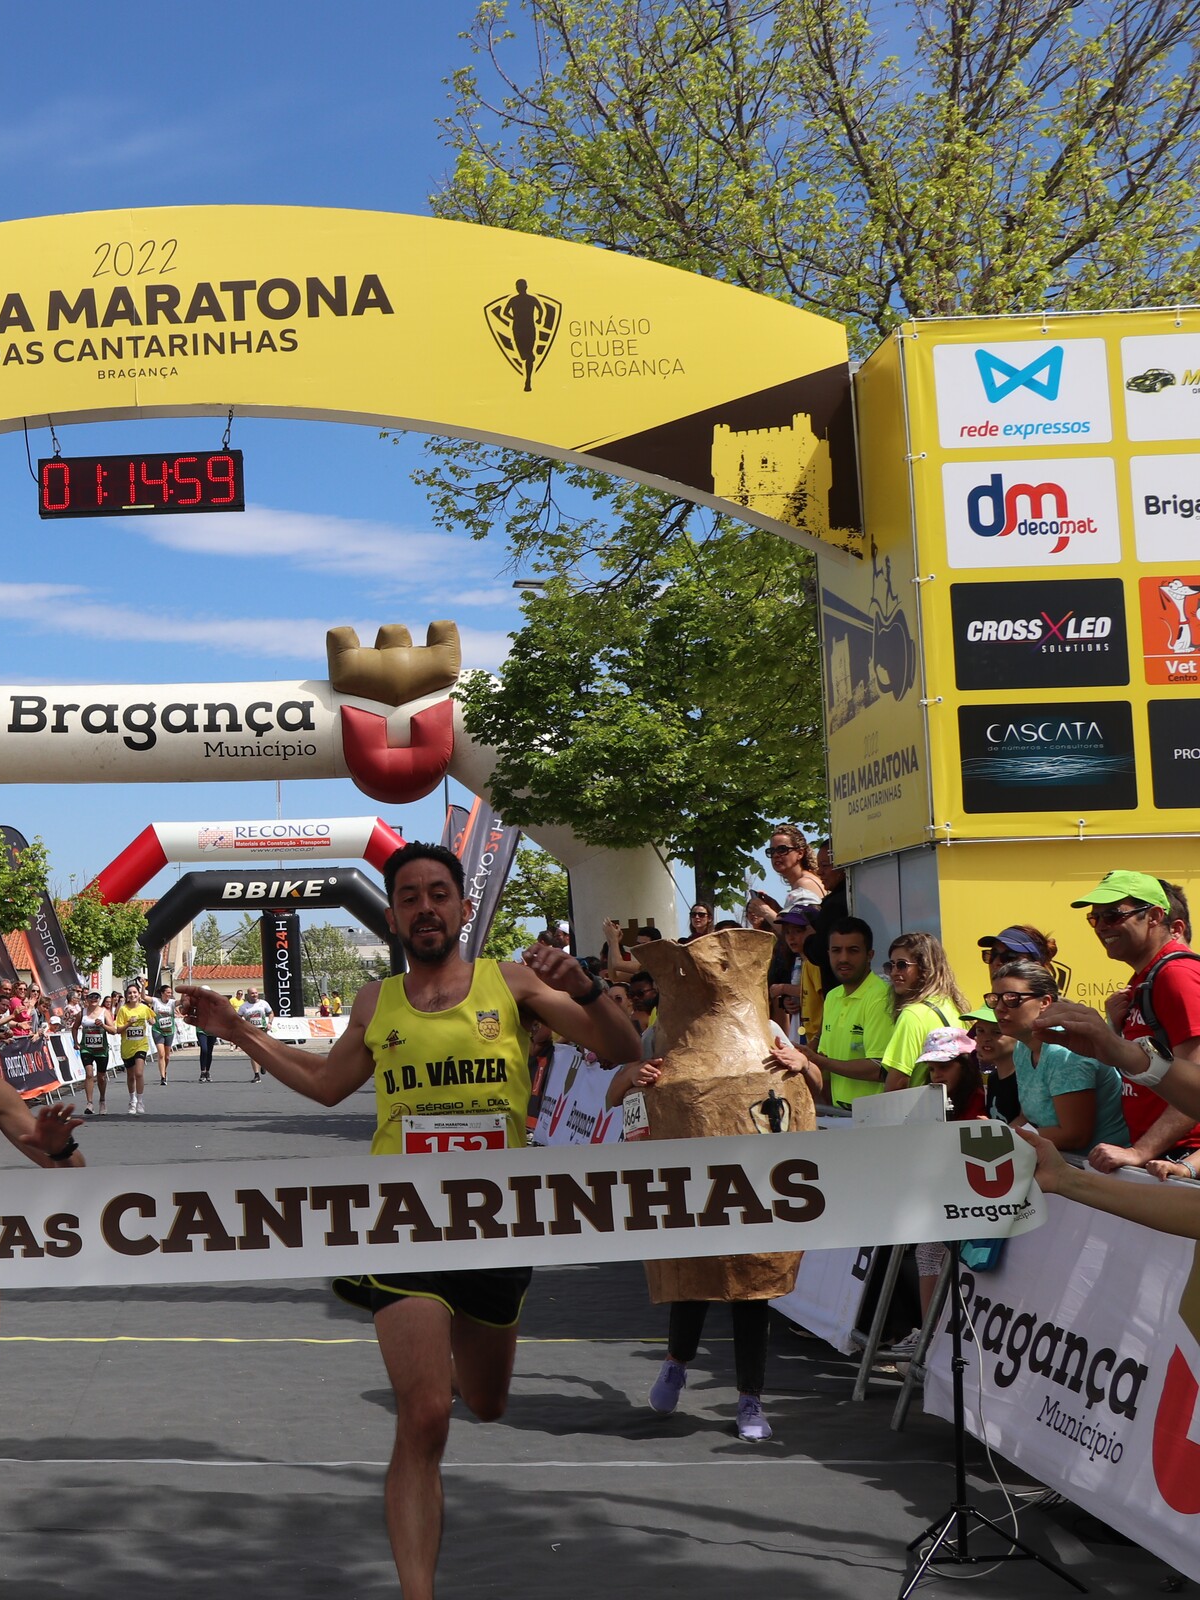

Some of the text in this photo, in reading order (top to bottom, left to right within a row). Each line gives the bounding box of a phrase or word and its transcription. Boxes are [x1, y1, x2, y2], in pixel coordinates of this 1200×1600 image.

[92, 239, 179, 278] 2022
[47, 274, 394, 331] MARATONA
[569, 315, 651, 337] GINÁSIO
[53, 328, 299, 362] CANTARINHAS
[570, 339, 639, 358] CLUBE
[97, 366, 179, 380] BRAGANÇA
[572, 358, 685, 380] BRAGANÇA
[960, 420, 1091, 440] rede expressos
[1018, 517, 1098, 536] decomat
[1165, 660, 1198, 674] Vet
[1167, 674, 1198, 682] Centro
[7, 695, 316, 751] Bragança
[986, 722, 1103, 743] CASCATA
[203, 738, 317, 761] Município
[833, 744, 919, 802] MEIA MARATONA
[848, 783, 902, 816] DAS CANTARINHAS
[235, 824, 330, 838] RECONCO
[266, 839, 296, 847] Construção
[299, 839, 330, 847] Transportes
[221, 879, 325, 899] BBIKE
[383, 1056, 508, 1095] U. D. VÁRZEA
[416, 1098, 510, 1112] SÉRGIO F. DIAS
[101, 1158, 826, 1257] CANTARINHAS
[945, 1272, 1149, 1421] Bragança
[1036, 1395, 1124, 1464] Município
